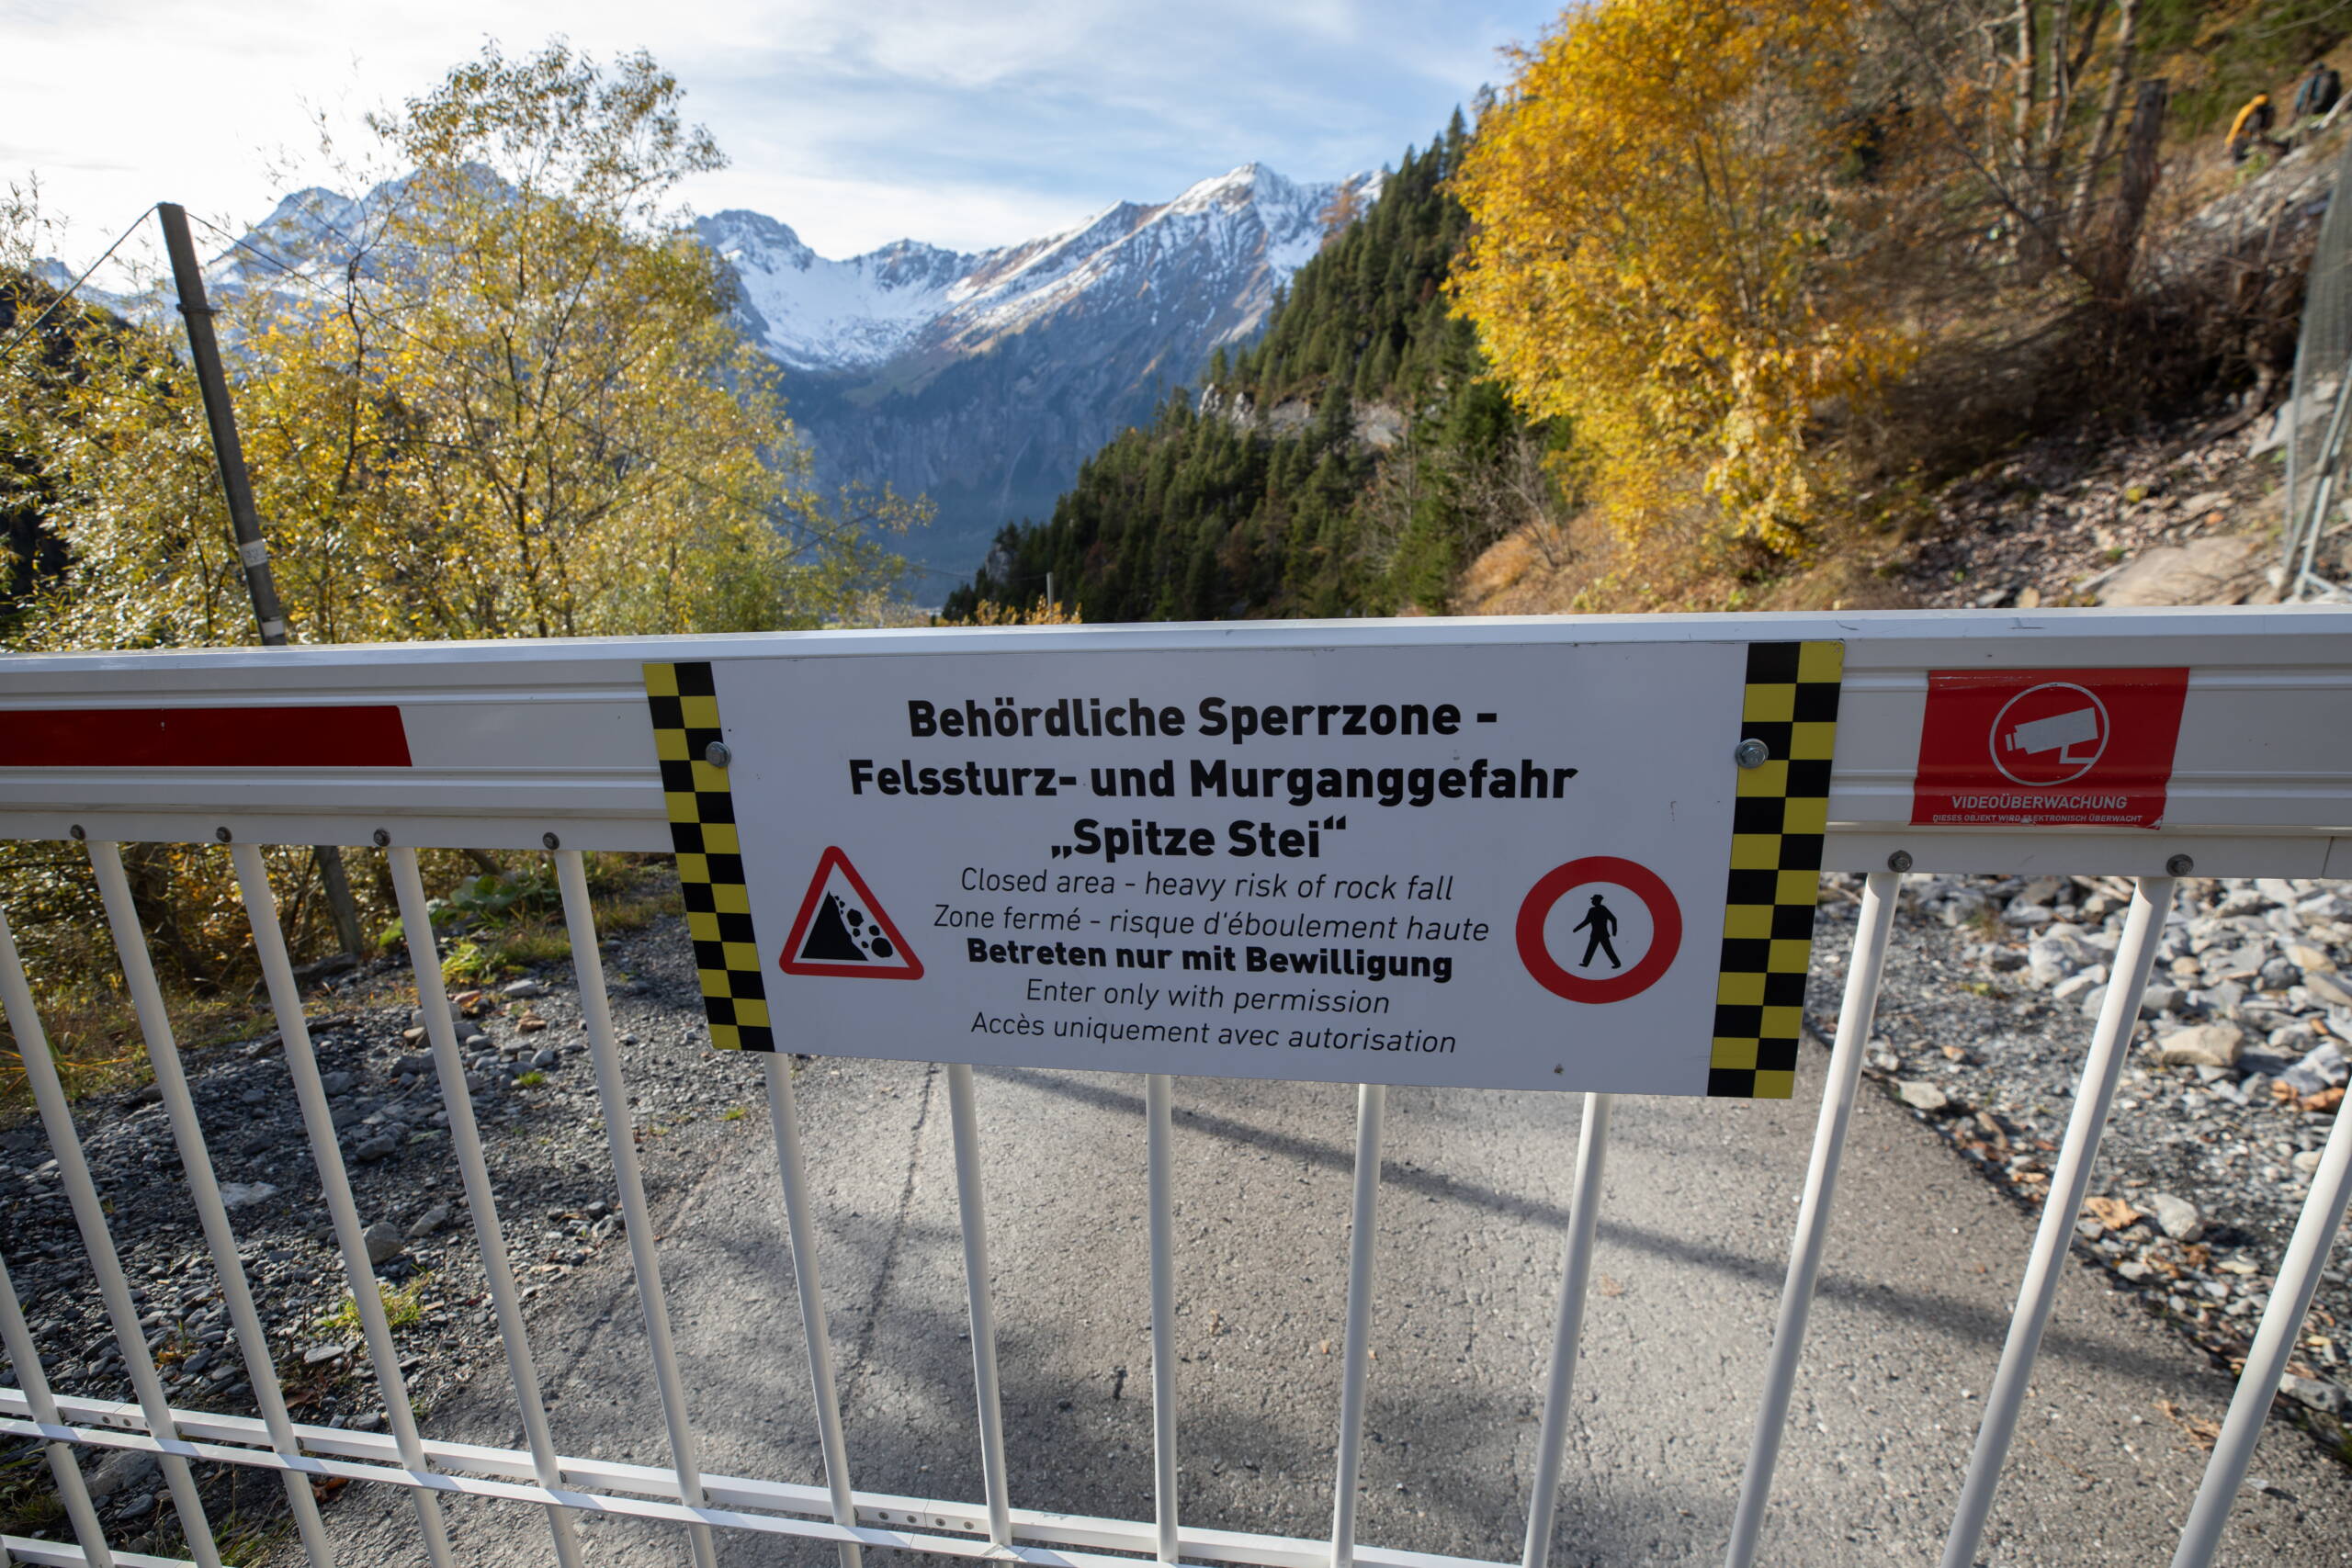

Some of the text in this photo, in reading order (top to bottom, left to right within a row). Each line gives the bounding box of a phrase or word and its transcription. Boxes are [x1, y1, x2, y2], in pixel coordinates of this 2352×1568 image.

[908, 697, 1185, 737] Behördliche
[1198, 696, 1461, 745] Sperrzone
[849, 759, 1578, 808] Felssturz- und Murganggefahr
[1951, 794, 2128, 809] VIDEOÜBERWACHUNG
[1932, 814, 1962, 822] DIESES
[1964, 814, 1997, 822] OBJEKT
[1998, 814, 2020, 822] WIRD
[2089, 814, 2143, 822] ÜBERWACHT
[1051, 817, 1215, 863] „Spitze
[961, 866, 1047, 893] Closed
[1057, 874, 1115, 895] area
[1145, 870, 1227, 902] heavy
[1235, 872, 1288, 897] risk
[1297, 874, 1328, 898] of
[1333, 874, 1396, 900] rock
[1407, 874, 1453, 901] fall
[933, 903, 994, 929] Zone
[1003, 906, 1081, 931] fermé
[1110, 908, 1194, 940] risque
[1406, 915, 1489, 942] haute
[967, 938, 1453, 984] Betreten nur mit Bewilligung
[1026, 977, 1390, 1015] Enter only with permission
[970, 1011, 1456, 1054] Accès uniquement avec autorisation
